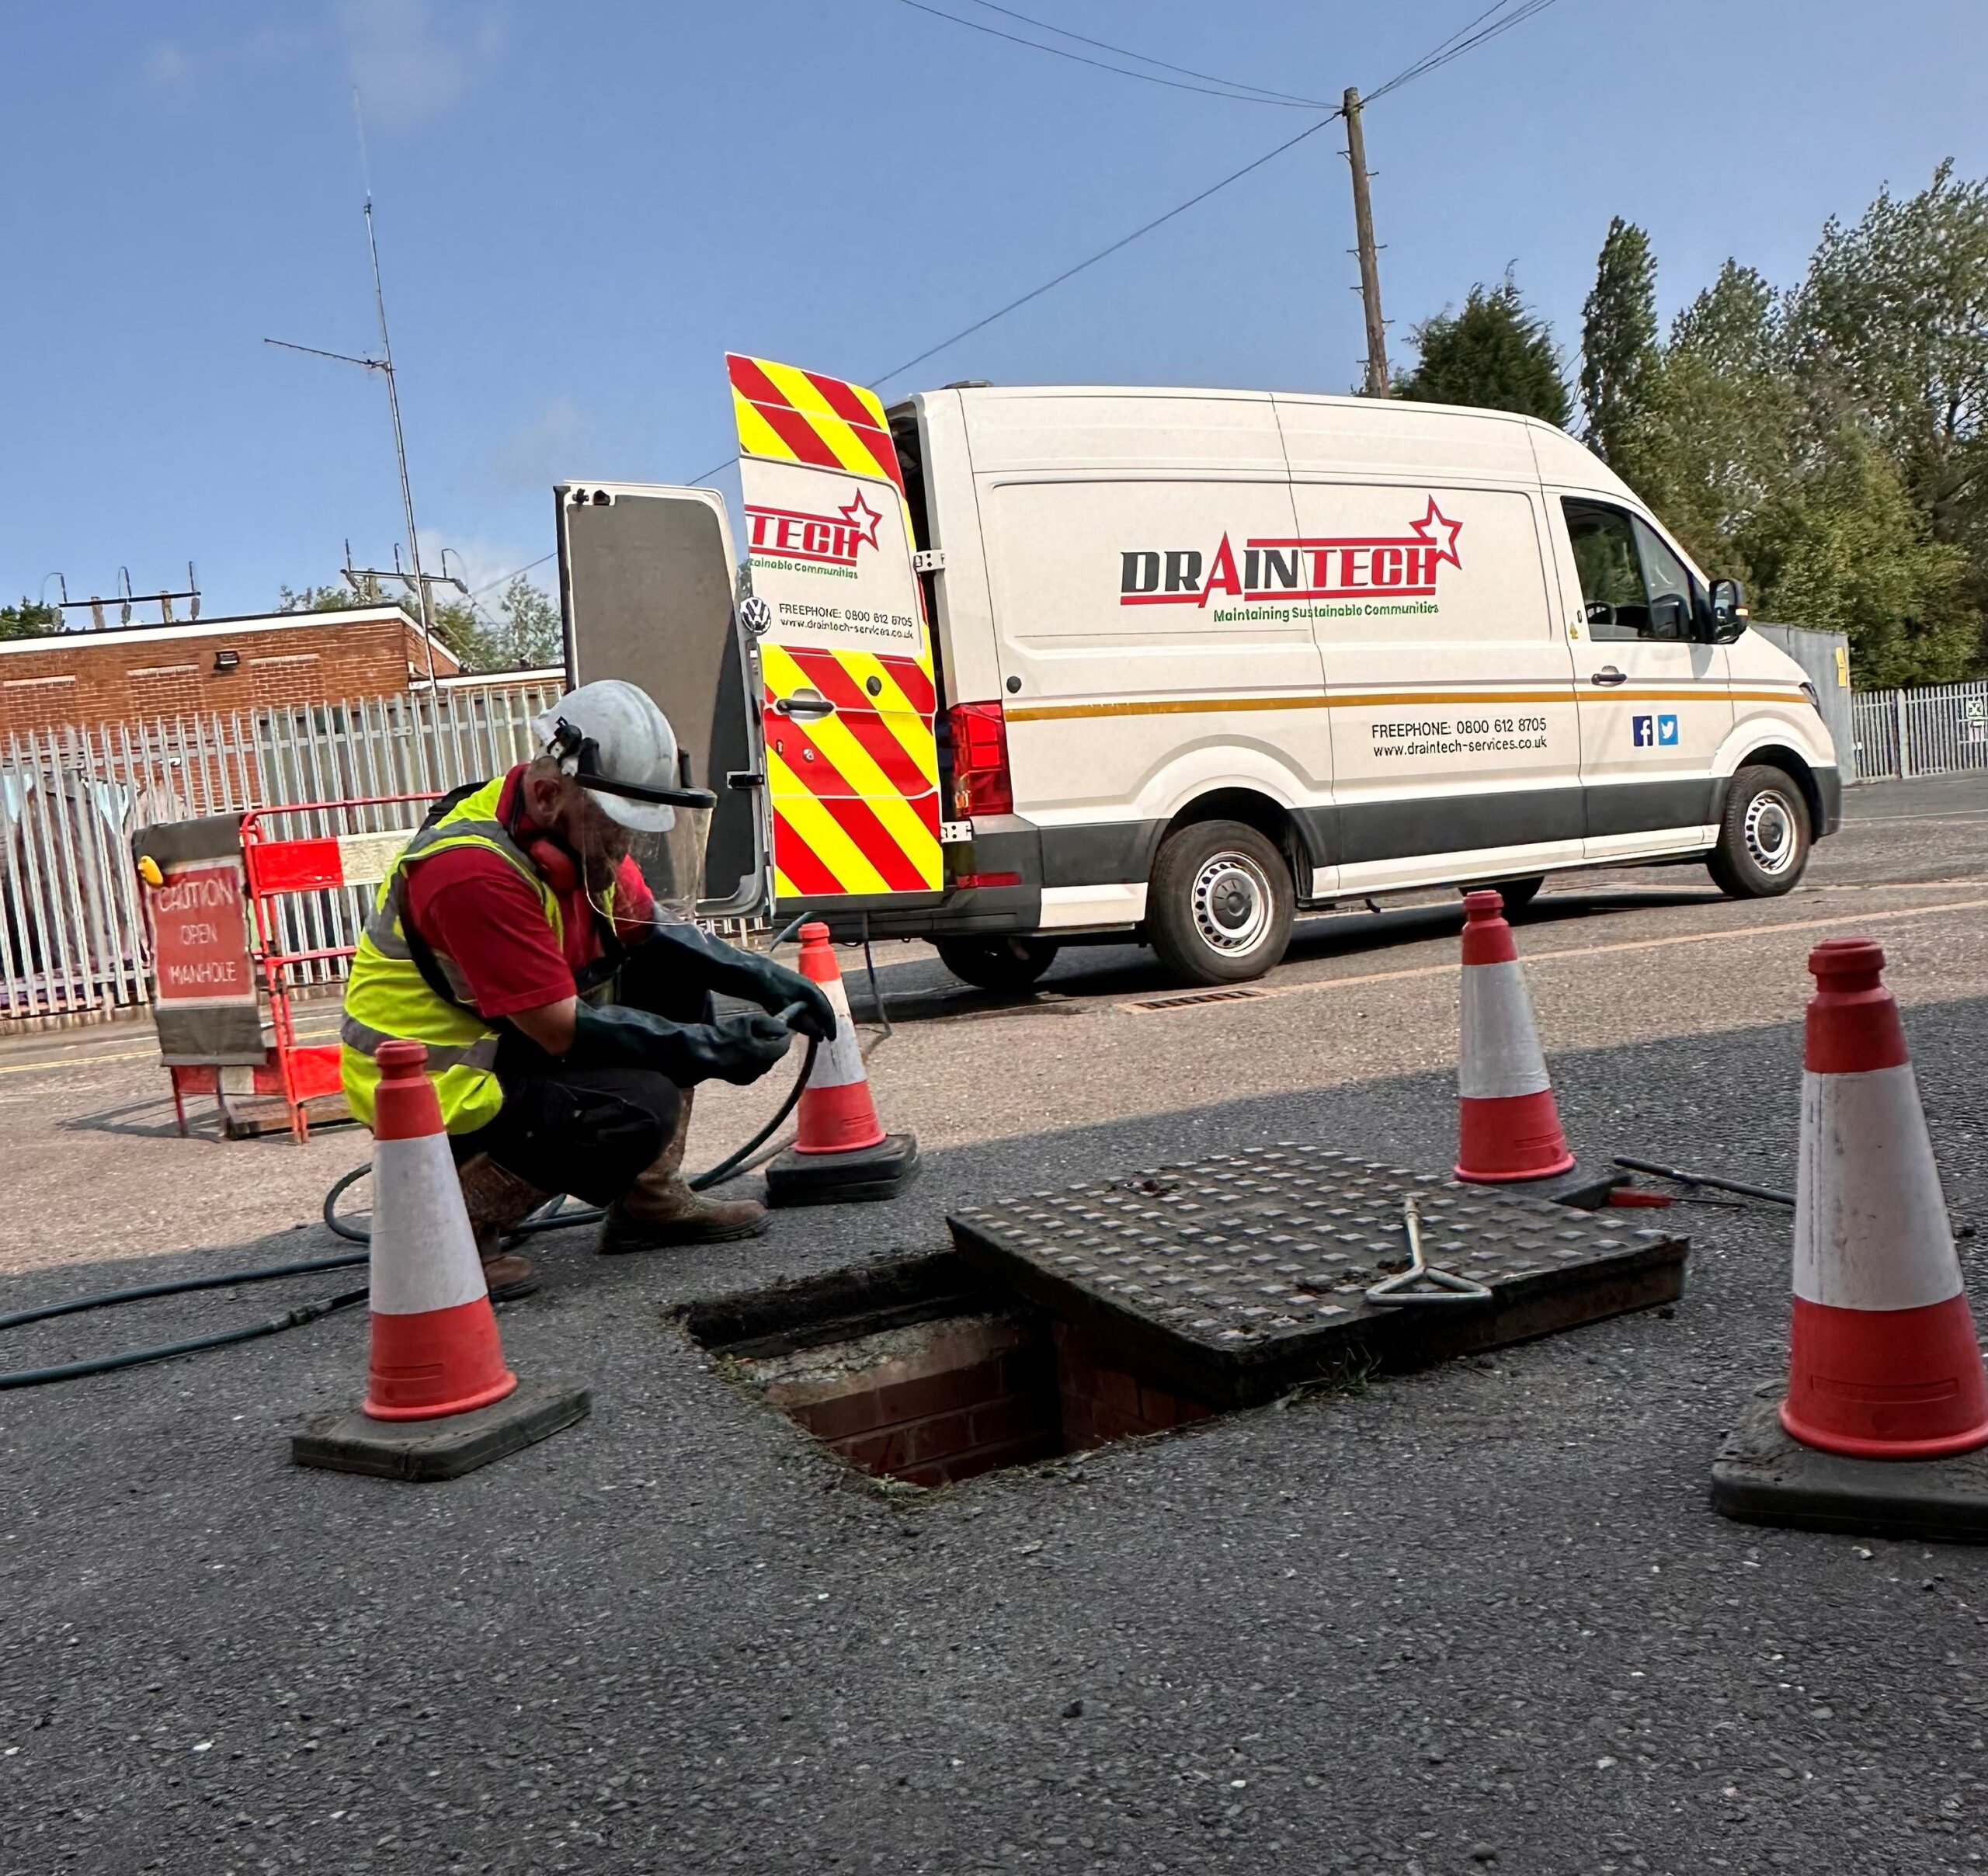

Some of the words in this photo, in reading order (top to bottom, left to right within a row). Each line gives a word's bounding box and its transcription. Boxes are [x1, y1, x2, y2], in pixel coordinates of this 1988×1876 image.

[746, 513, 860, 558] TECH
[794, 563, 858, 579] Communities
[1121, 530, 1437, 608] DRAINTECH
[779, 603, 842, 619] FREEPHONE:
[845, 610, 870, 622] 0800
[874, 613, 888, 624] 612
[1214, 606, 1290, 622] Maintaining
[1292, 603, 1362, 619] Sustainable
[1364, 601, 1439, 616] Communities
[1371, 721, 1451, 738] FREEPHONE:
[1456, 720, 1489, 735] 0800
[1493, 718, 1514, 733] 612
[1518, 717, 1547, 732] 8705
[1373, 735, 1548, 756] www.draintech-services.co.uk
[158, 877, 234, 912] CAUTION
[181, 922, 218, 945] OPEN
[169, 961, 237, 985] MANHOLE
